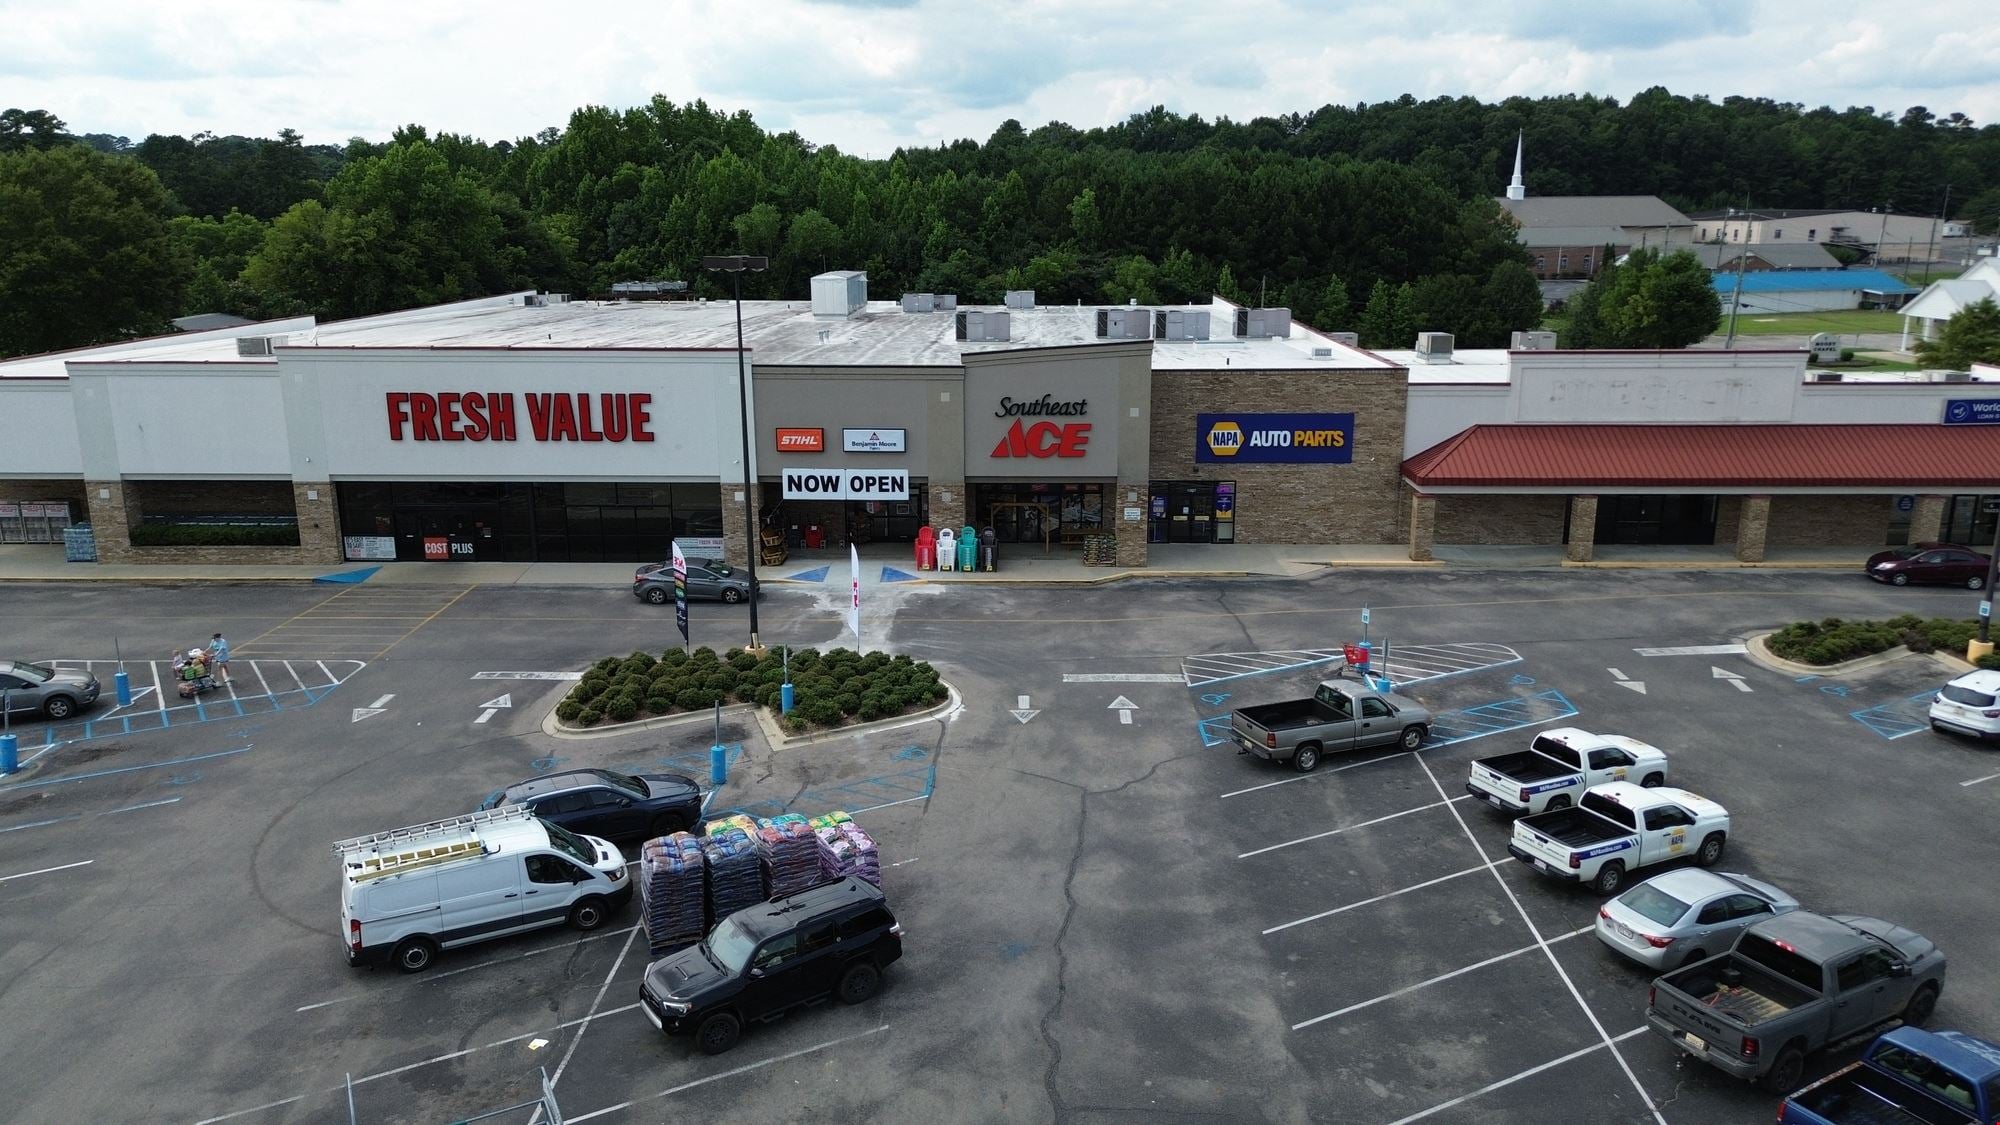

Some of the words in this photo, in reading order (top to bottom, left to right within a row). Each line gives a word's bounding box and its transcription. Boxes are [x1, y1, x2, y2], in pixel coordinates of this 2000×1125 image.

[995, 394, 1087, 417] Southeast
[386, 392, 517, 441] FRESH
[525, 393, 655, 442] VALUE
[781, 435, 818, 445] STIHL
[990, 417, 1092, 458] ACE
[1213, 431, 1239, 446] NAPA
[1250, 430, 1291, 447] AUTO
[1294, 430, 1345, 447] PARTS
[787, 475, 840, 493] NOW
[850, 476, 905, 493] OPEN
[425, 542, 447, 554] COST
[451, 542, 473, 554] PLUS
[1671, 834, 1684, 845] NAPA
[1590, 844, 1623, 857] NAPAonline.com
[1673, 1004, 1721, 1035] RAM
